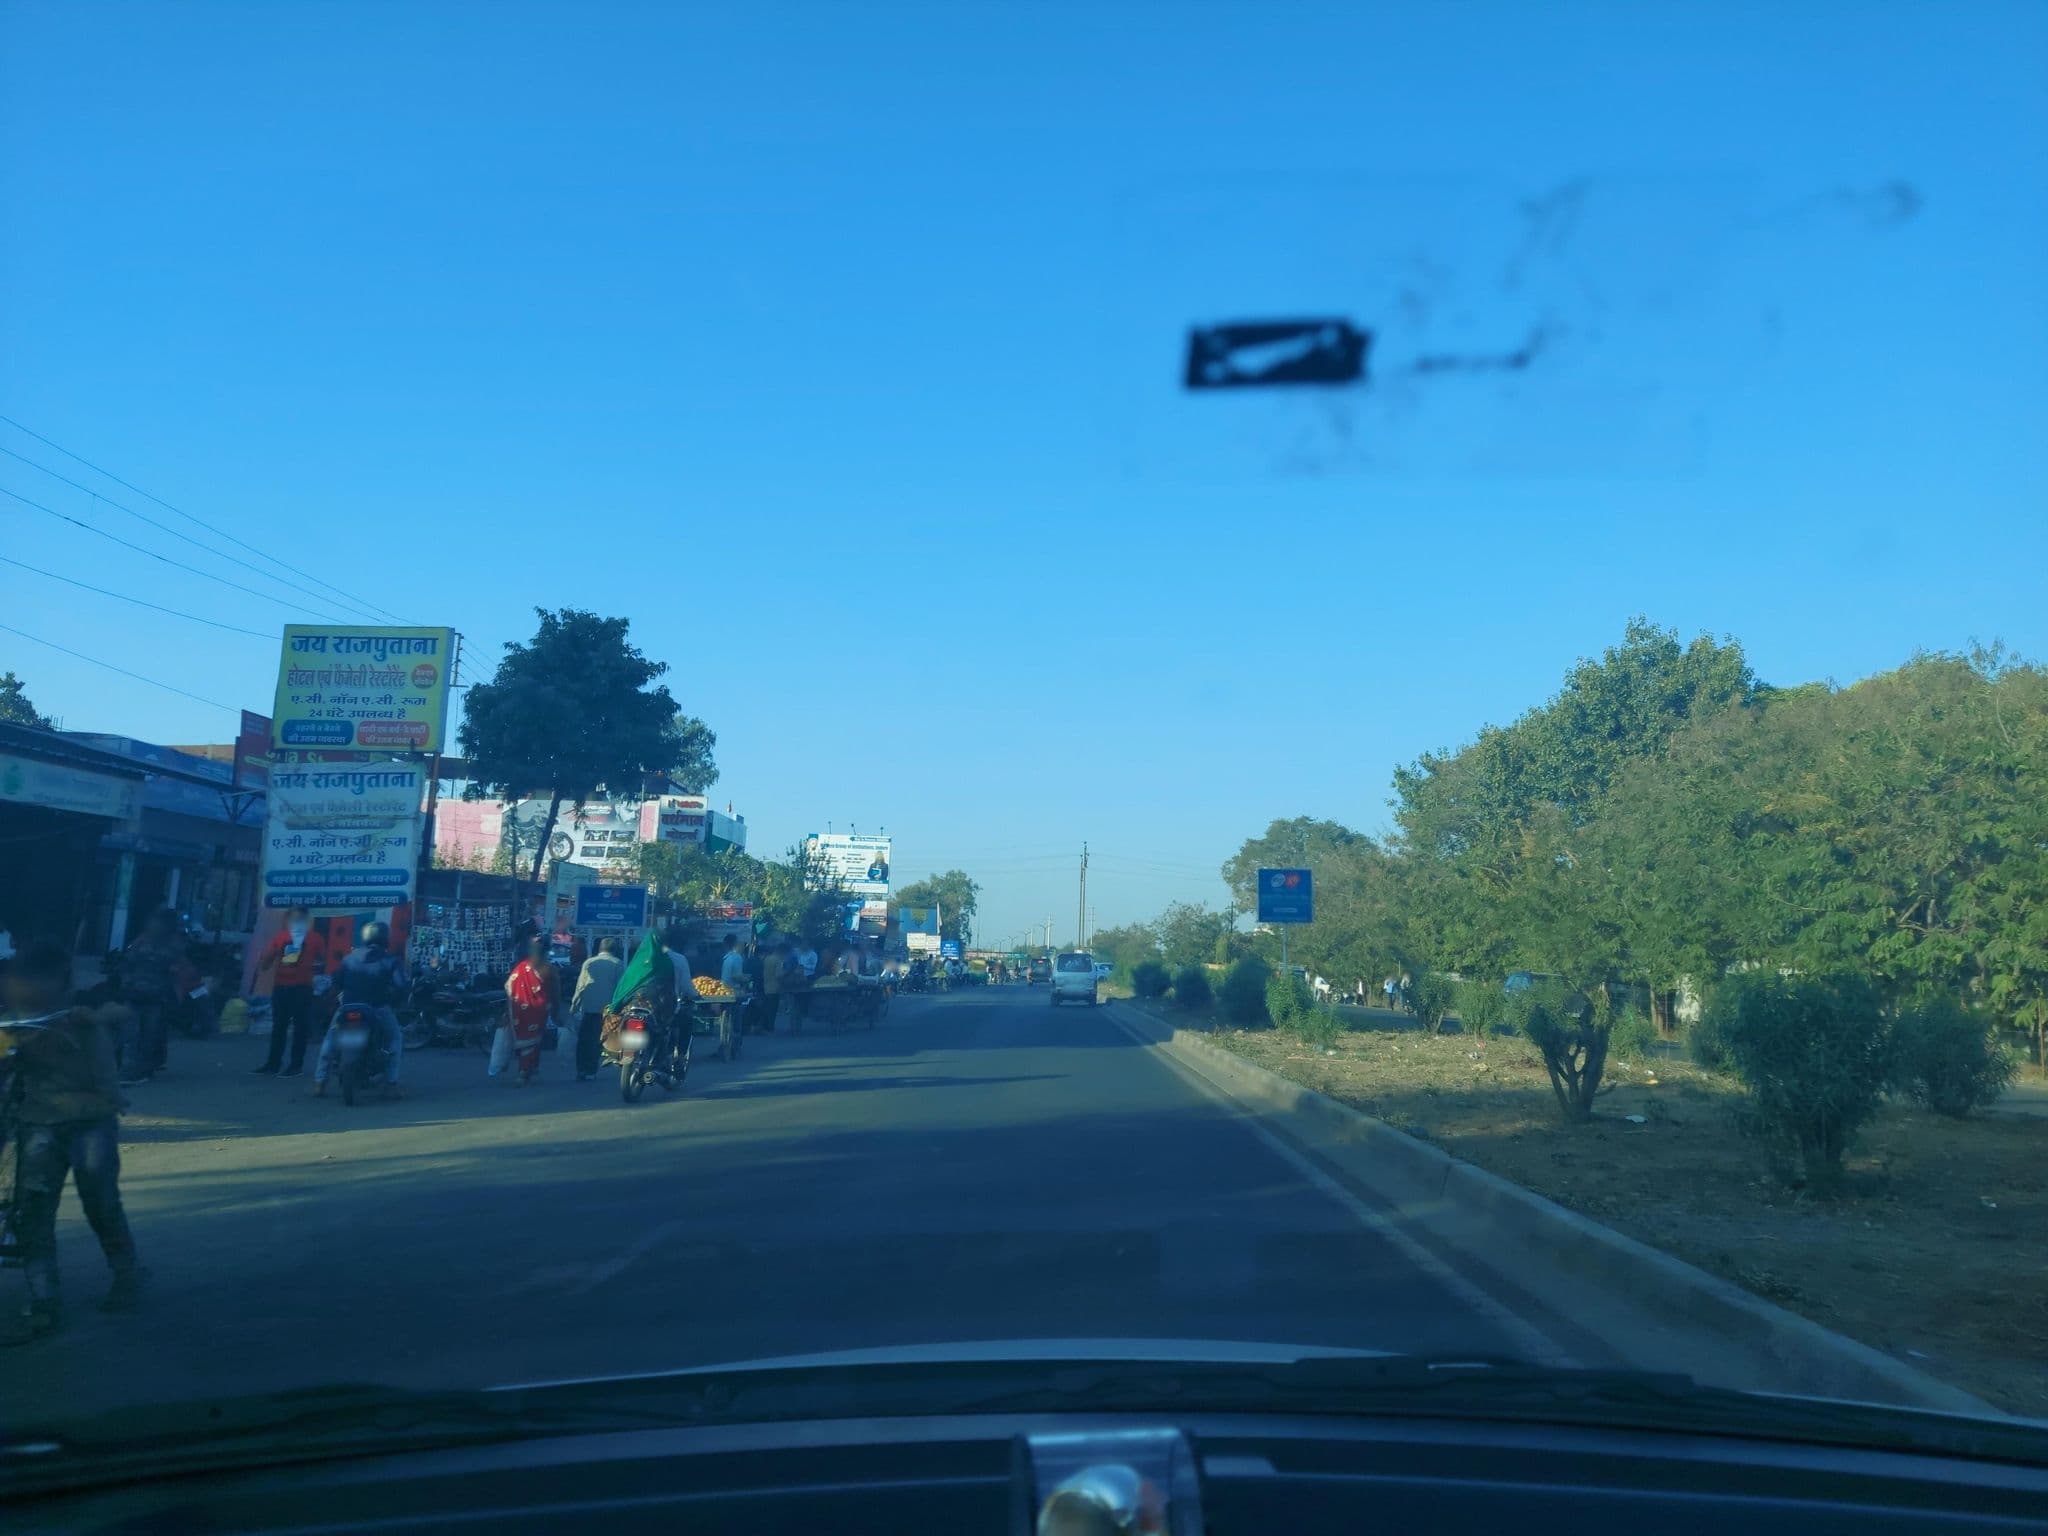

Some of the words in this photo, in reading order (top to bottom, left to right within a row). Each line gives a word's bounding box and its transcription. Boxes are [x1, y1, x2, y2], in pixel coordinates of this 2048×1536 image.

[291, 635, 329, 653] जय
[333, 636, 439, 662] राजपुताना
[287, 663, 315, 688] होटल
[291, 693, 326, 705] ए.सी.
[329, 693, 358, 706] नॉन
[400, 697, 427, 706] रूम
[309, 709, 322, 718] 24
[326, 708, 344, 718] घंटे
[397, 708, 406, 719] है
[273, 773, 309, 789] जय
[312, 772, 417, 794] राजपुताना
[272, 835, 306, 848] ए.सी.
[309, 834, 336, 848] नॉन
[381, 836, 408, 848] रूम
[289, 855, 302, 865] 24
[306, 853, 324, 865] घंटे
[376, 851, 387, 865] है
